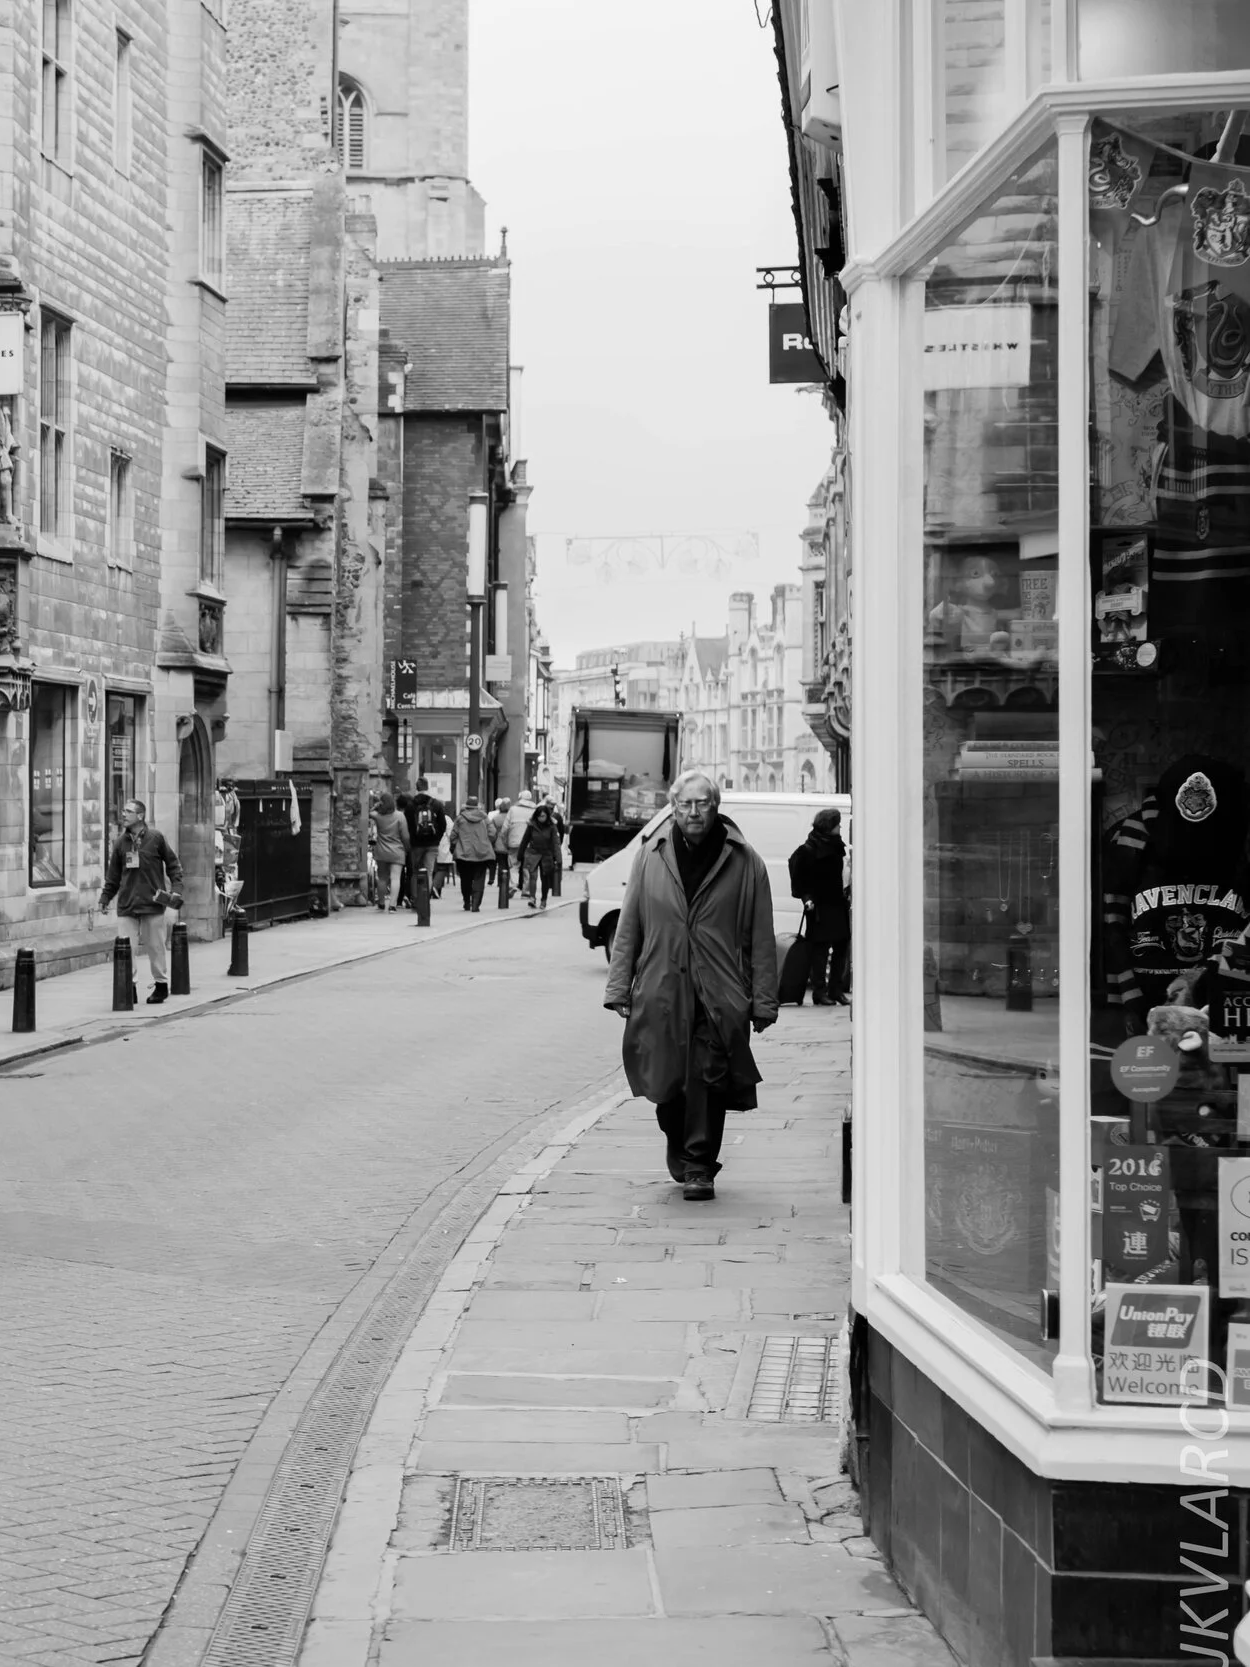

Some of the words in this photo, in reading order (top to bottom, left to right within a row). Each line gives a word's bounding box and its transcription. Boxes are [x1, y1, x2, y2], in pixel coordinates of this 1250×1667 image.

[468, 737, 481, 746] 20
[1007, 759, 1044, 768] SPELLS
[1136, 1046, 1155, 1058] EF
[1108, 1158, 1162, 1177] 2016
[1109, 1182, 1127, 1192] Top
[1129, 1182, 1162, 1192] Choice
[1230, 1248, 1249, 1266] IS
[1119, 1305, 1194, 1327] UnionPay
[1147, 1323, 1187, 1339] 银联
[1108, 1351, 1201, 1374] 欢迎光临
[1108, 1376, 1199, 1396] Welcome
